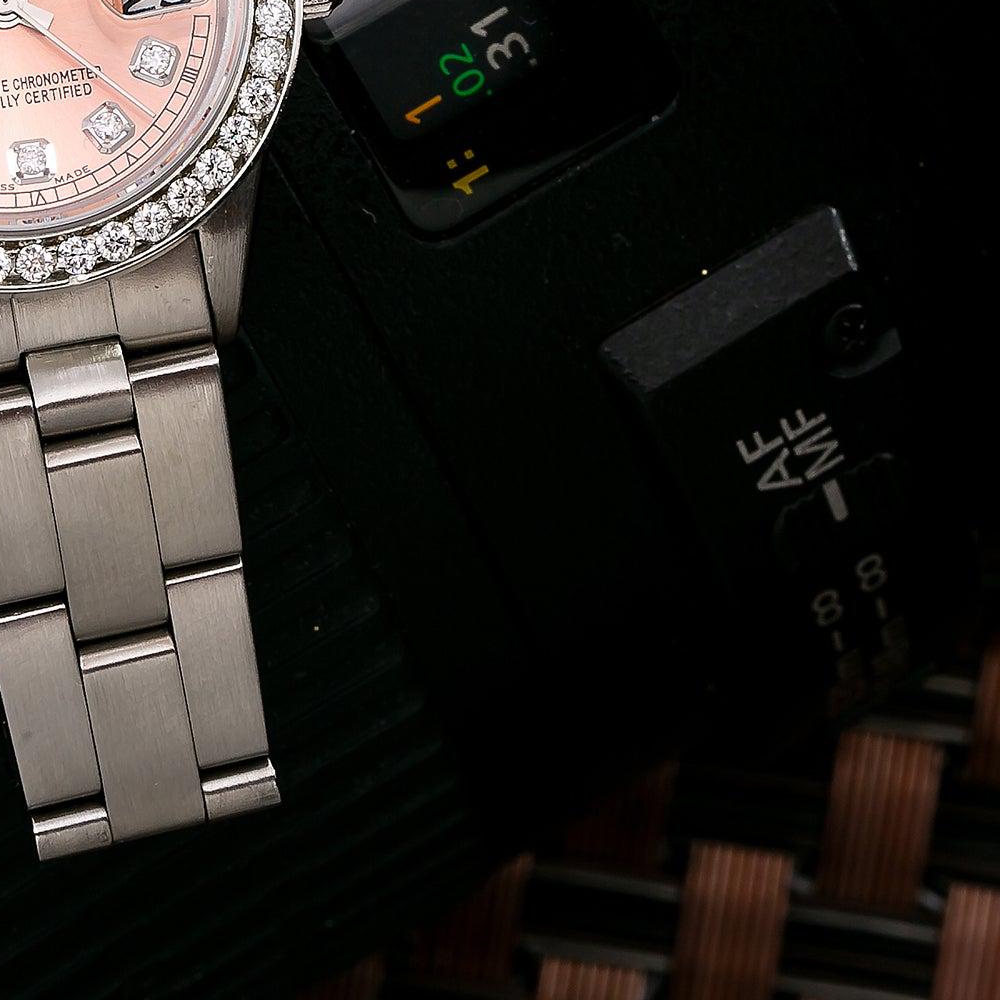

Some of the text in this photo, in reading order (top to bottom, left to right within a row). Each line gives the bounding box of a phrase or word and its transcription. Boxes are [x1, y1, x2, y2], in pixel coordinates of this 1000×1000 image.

[24, 83, 93, 104] CERTIFIED
[54, 165, 91, 184] MADE
[736, 431, 804, 491] AF
[780, 409, 845, 481] MF
